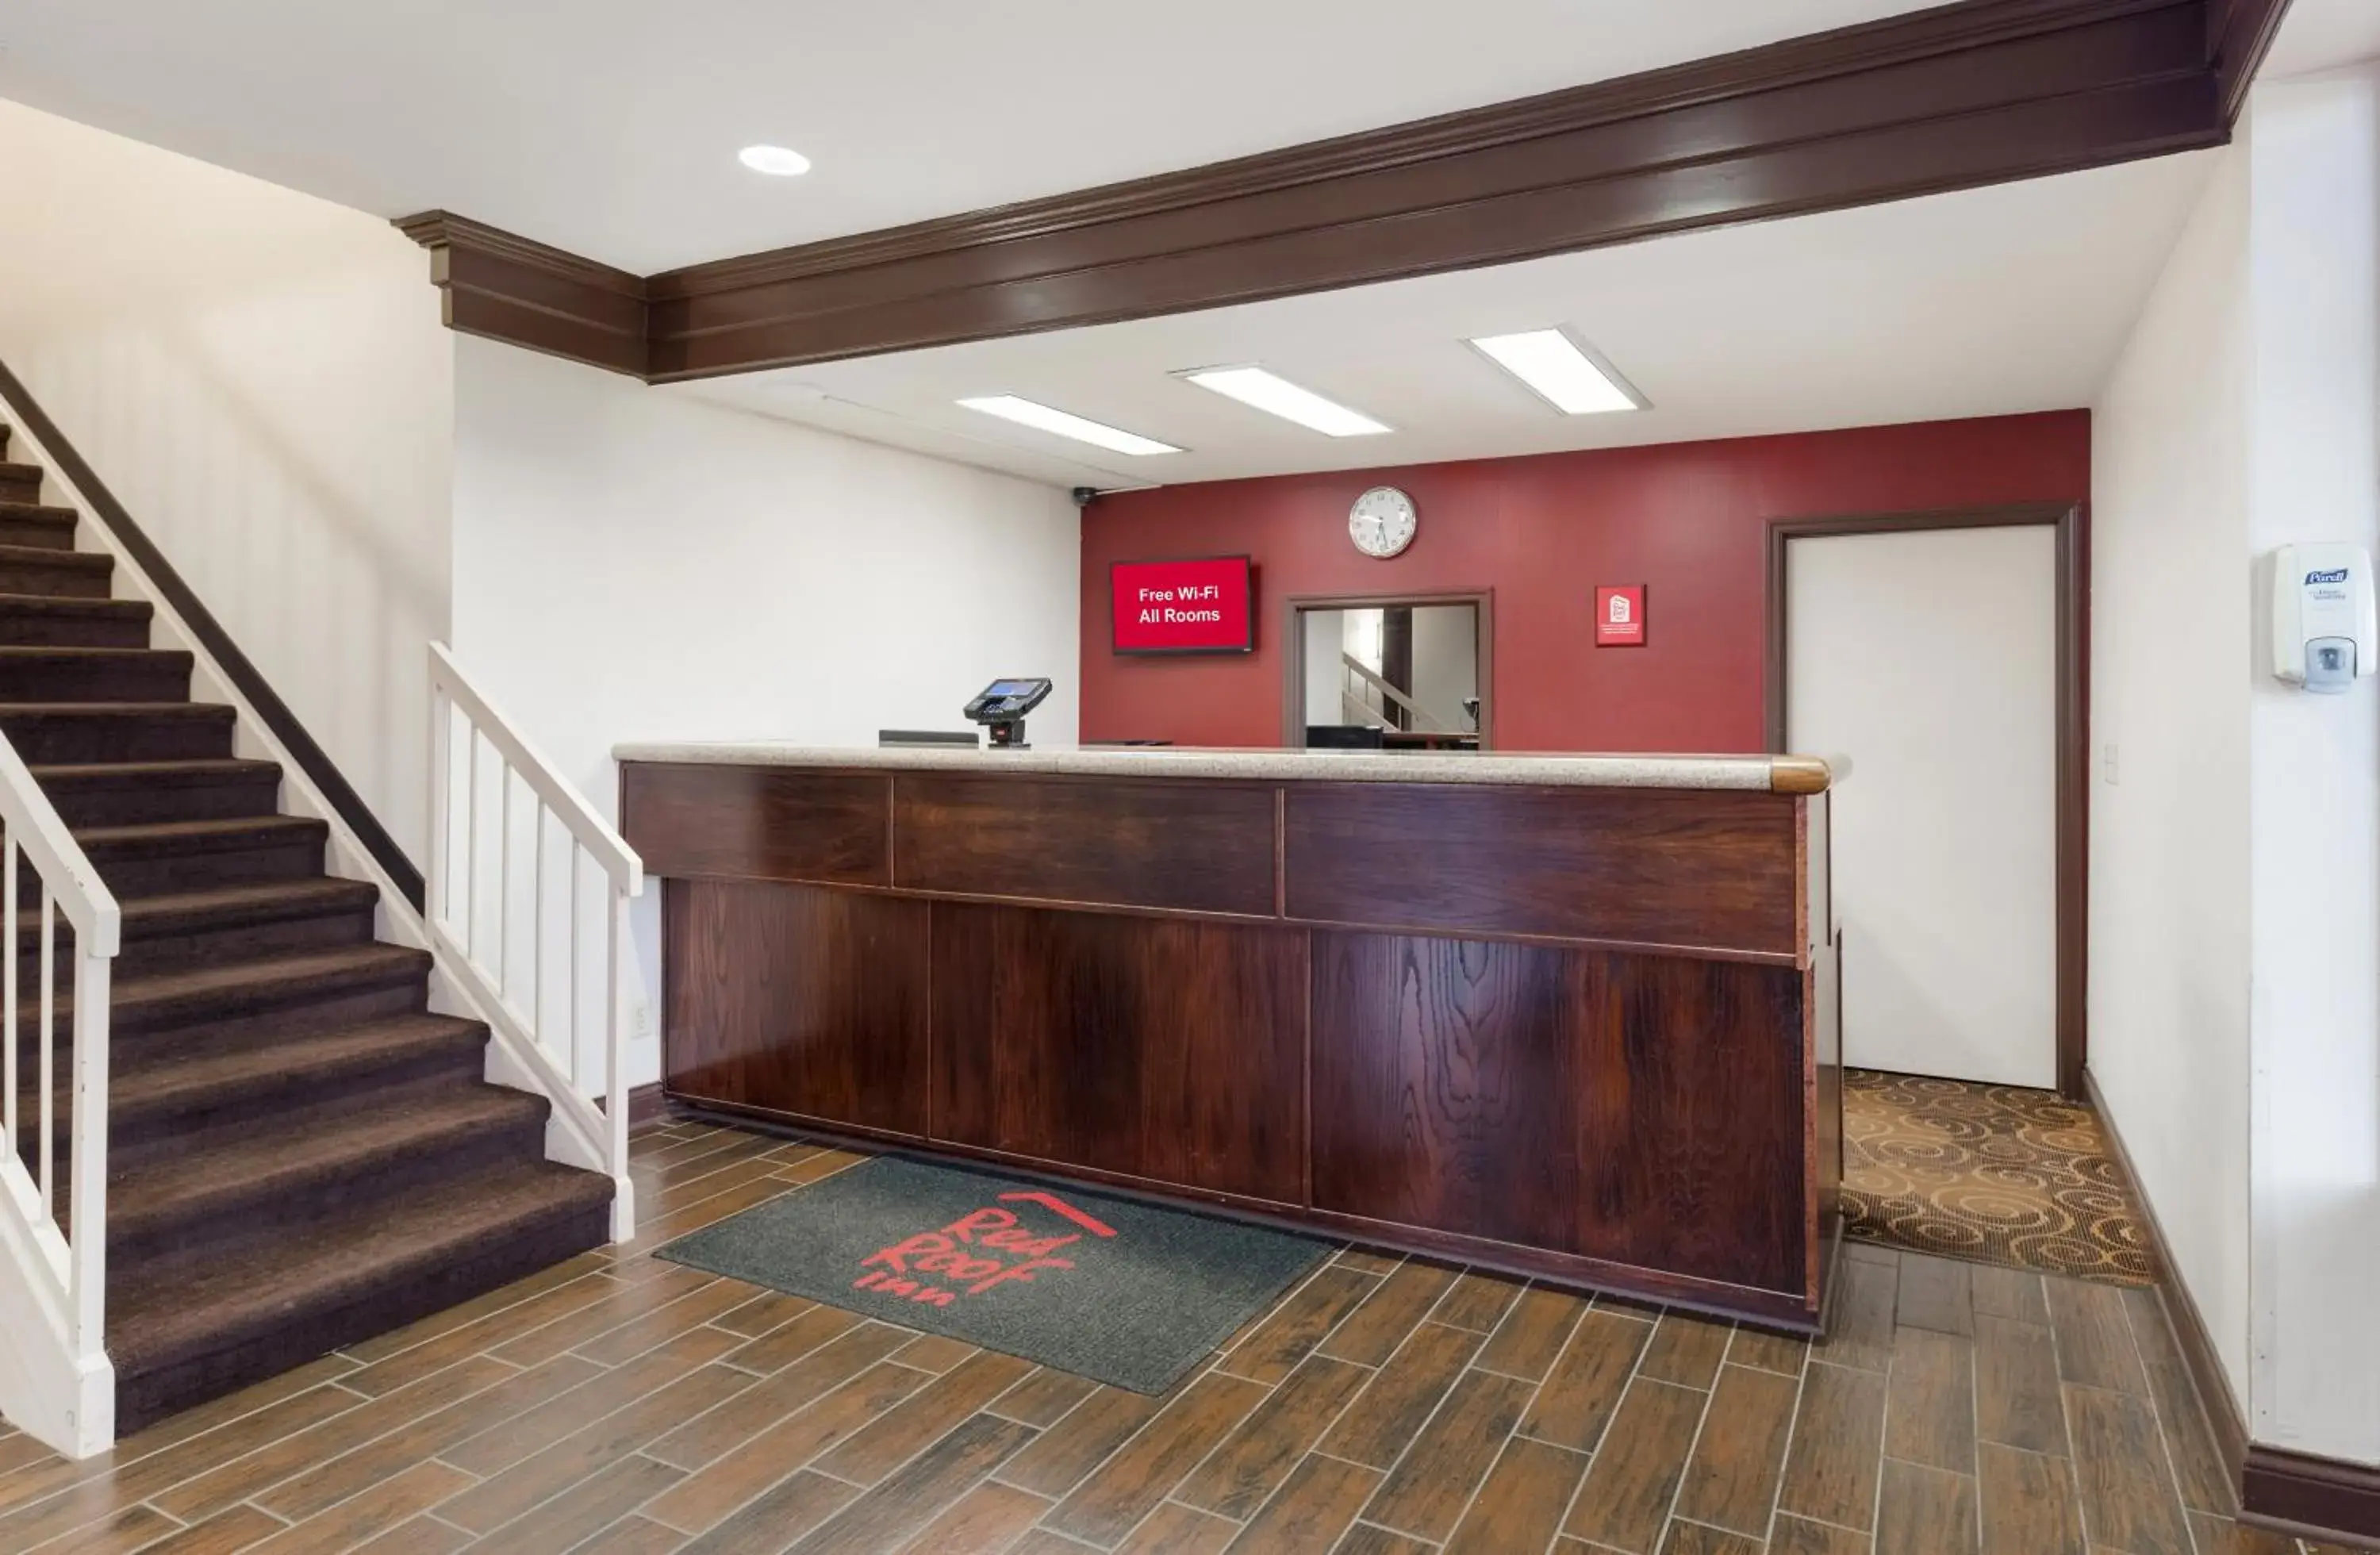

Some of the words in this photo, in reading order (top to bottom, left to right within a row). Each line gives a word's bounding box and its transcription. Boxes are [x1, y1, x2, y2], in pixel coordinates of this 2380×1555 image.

[1138, 588, 1174, 602] Free
[1177, 586, 1219, 601] Wi-Fi
[1139, 609, 1160, 623] All
[1165, 607, 1220, 623] Rooms
[940, 1206, 1082, 1256] Red
[861, 1231, 1076, 1296] Roof
